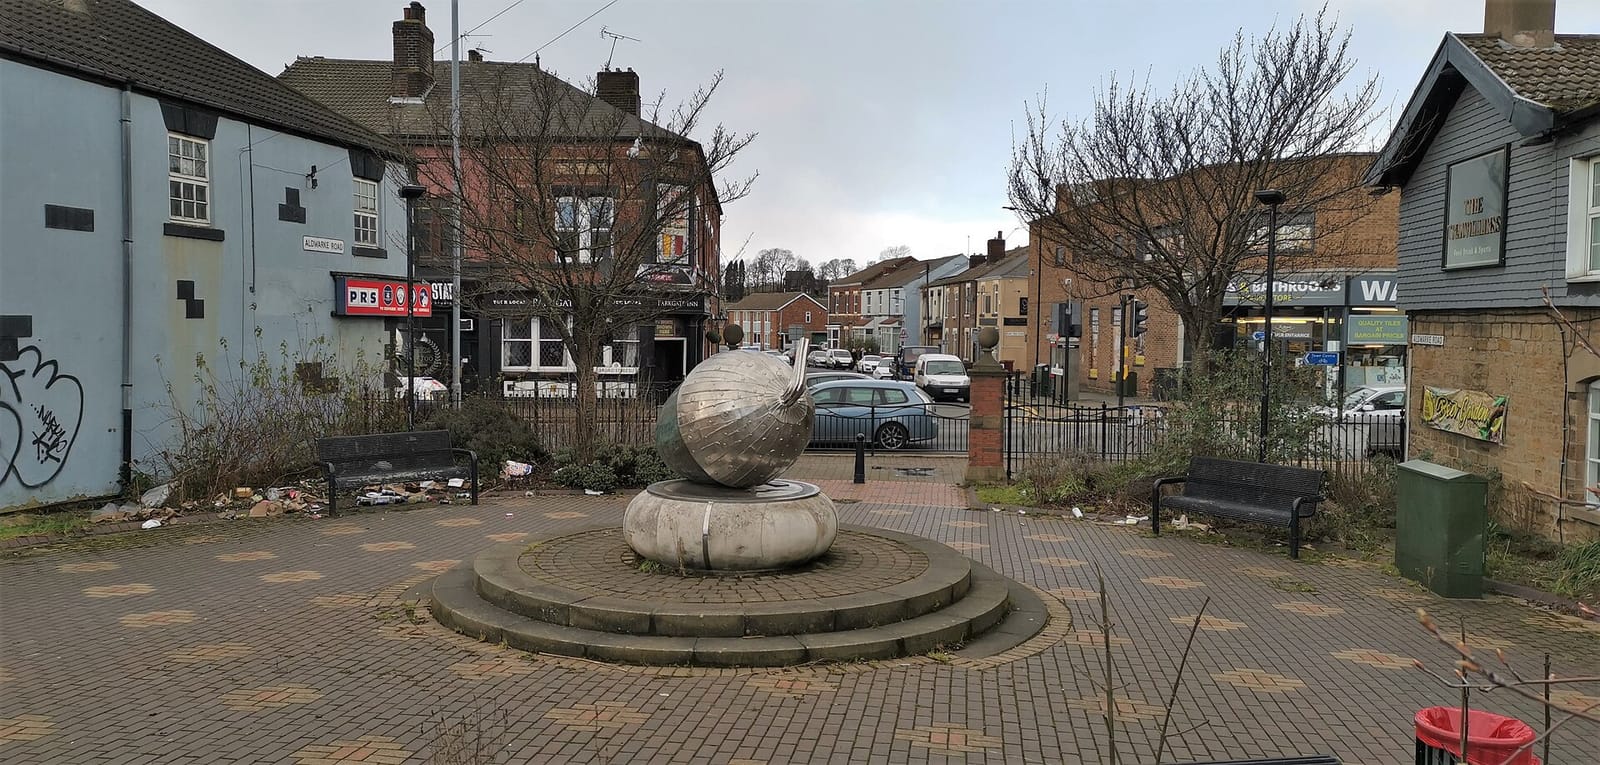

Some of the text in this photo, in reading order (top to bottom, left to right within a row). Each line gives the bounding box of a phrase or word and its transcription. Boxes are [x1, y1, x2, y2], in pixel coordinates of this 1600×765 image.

[1464, 197, 1484, 215] THE
[331, 242, 344, 251] ROAD
[350, 290, 378, 304] PRS
